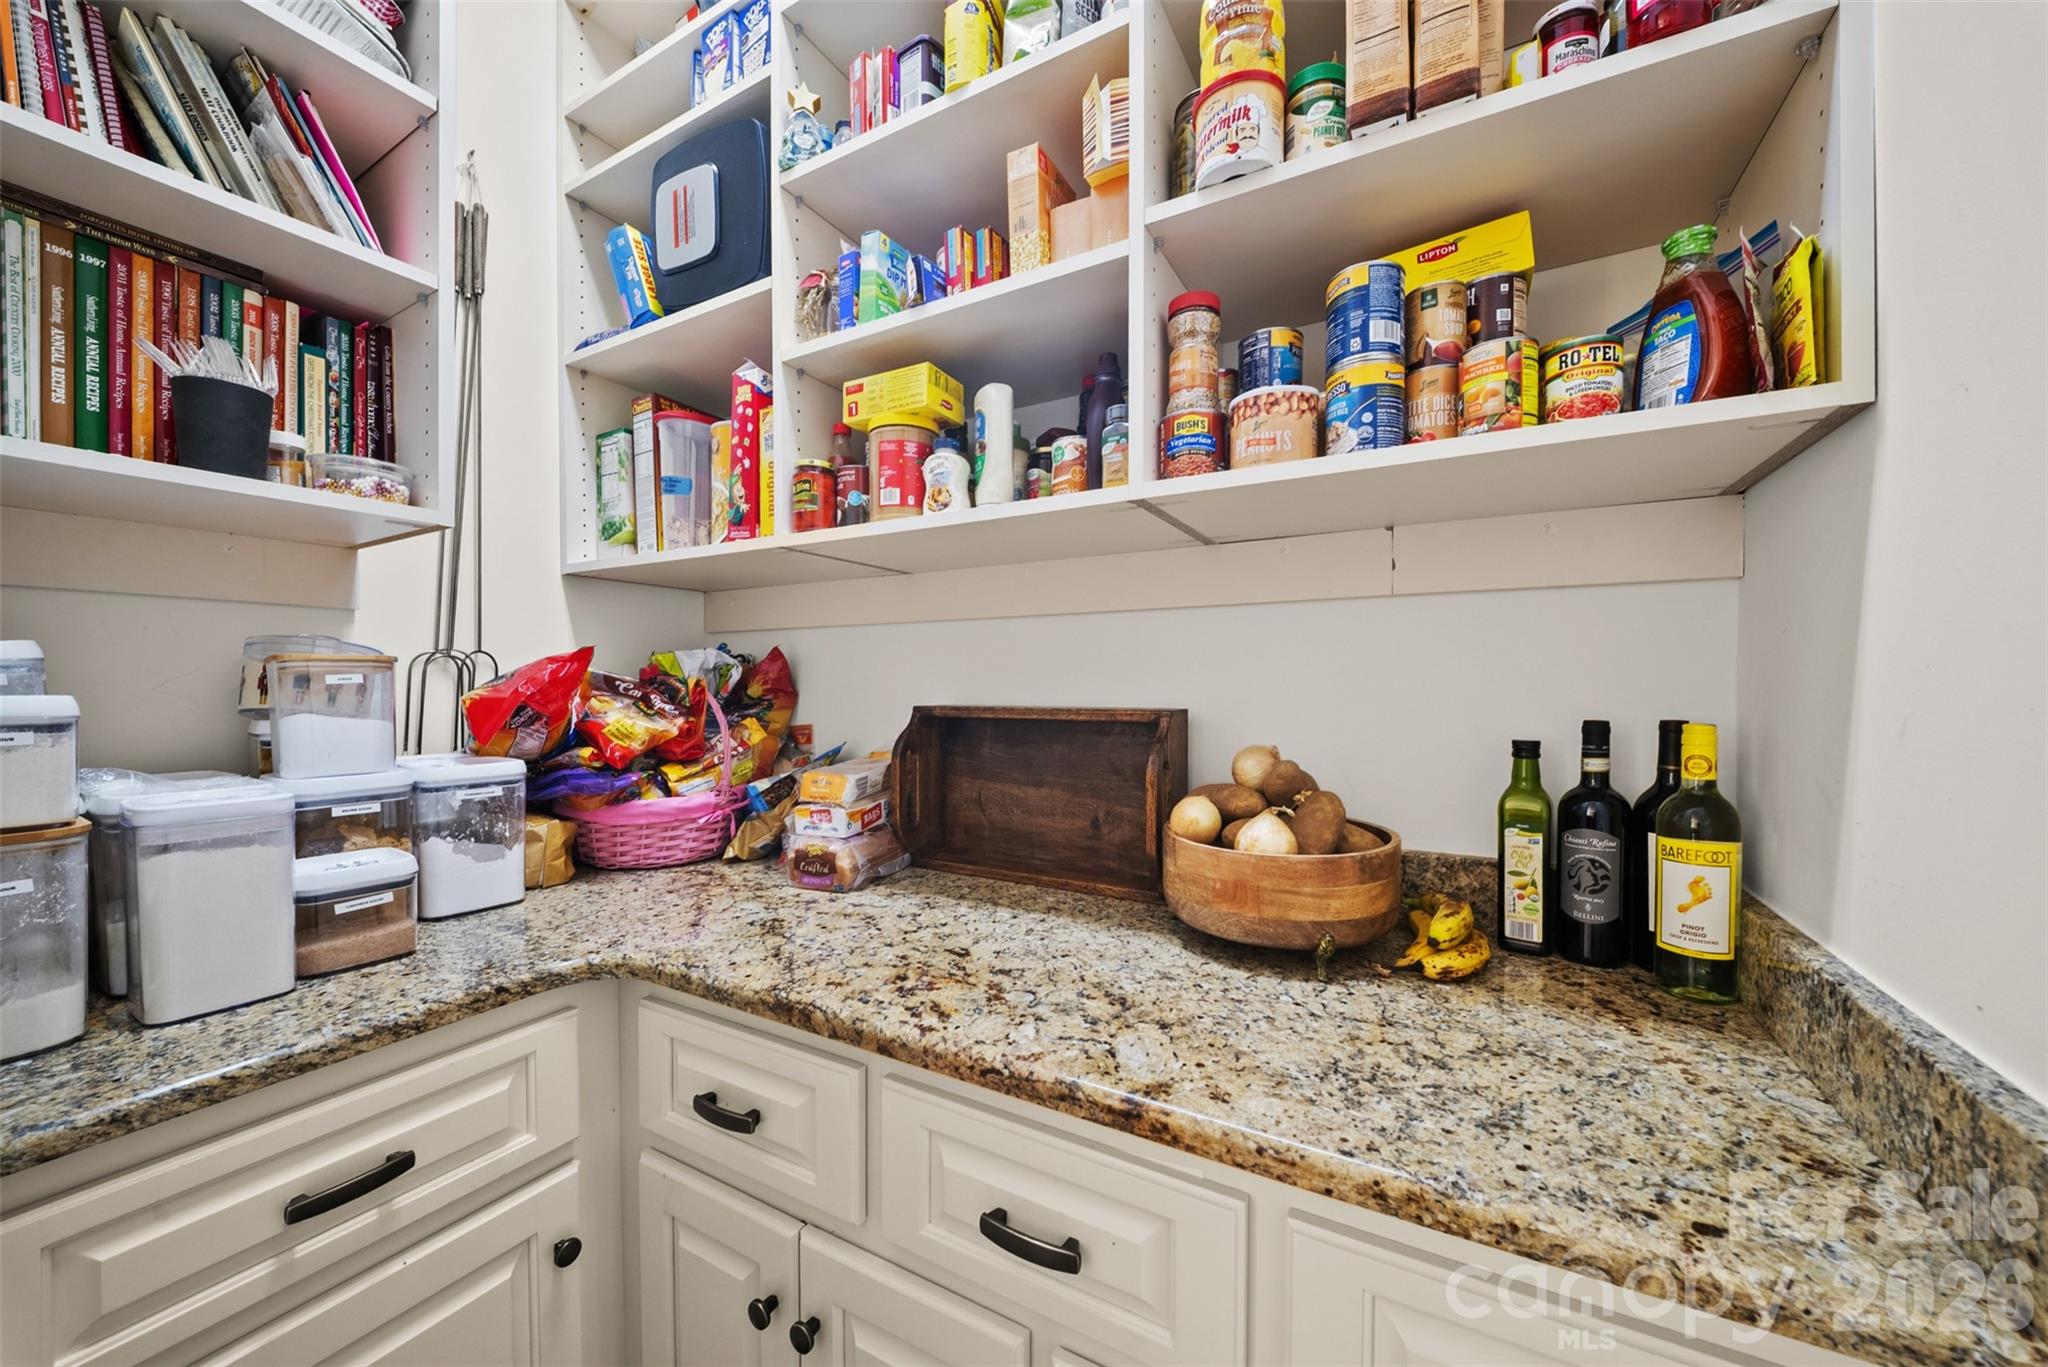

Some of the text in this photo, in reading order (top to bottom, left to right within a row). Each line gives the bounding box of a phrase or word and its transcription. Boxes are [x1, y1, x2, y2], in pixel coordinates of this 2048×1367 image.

[58, 48, 68, 72] SODA
[1555, 46, 1595, 63] Maraschino
[200, 87, 215, 110] MEAT
[212, 108, 238, 153] COOKBOOK
[1313, 126, 1335, 137] PEANUT
[80, 212, 127, 234] FORGOTTEN
[45, 243, 73, 259] 1996
[79, 253, 107, 268] 1997
[632, 238, 647, 267] SIZE
[1419, 244, 1457, 262] LIPTON
[9, 255, 19, 268] The
[8, 269, 20, 284] Best
[642, 267, 657, 301] LARGE
[886, 267, 900, 282] DIP
[161, 280, 172, 300] 1996
[139, 293, 148, 313] Taste
[161, 302, 171, 323] Taste
[187, 308, 196, 328] Taste
[209, 314, 219, 334] Taste
[113, 263, 127, 409] 2001 Taste of Home Annual Recipes
[160, 324, 172, 333] of
[230, 320, 240, 340] Taste
[1655, 330, 1676, 345] TACO
[51, 327, 65, 364] ANNUAL
[86, 336, 100, 372] ANNUAL
[161, 334, 171, 354] Hom
[11, 358, 21, 376] 2000
[341, 352, 349, 370] Taste
[340, 370, 349, 378] of
[1464, 369, 1482, 381] PEACH
[1566, 367, 1613, 380] Original
[51, 366, 65, 405] RECIPES
[86, 374, 100, 412] RECIPES
[341, 380, 349, 400] Home
[136, 383, 148, 413] Recipes
[160, 390, 172, 421] Recipes
[341, 402, 349, 426] Annual
[1176, 419, 1206, 433] BUSH'S
[339, 427, 349, 453] Recipes
[1170, 435, 1212, 448] Vegetarian
[1235, 429, 1292, 460] PEANUTS
[1511, 849, 1534, 861] Olive
[1515, 860, 1530, 869] Oil
[1661, 844, 1732, 865] BAREFOOT
[800, 861, 829, 874] Crafted
[1573, 910, 1605, 922] BELLINI
[1679, 929, 1707, 939] GRIGIO
[1682, 923, 1705, 932] PINOT
